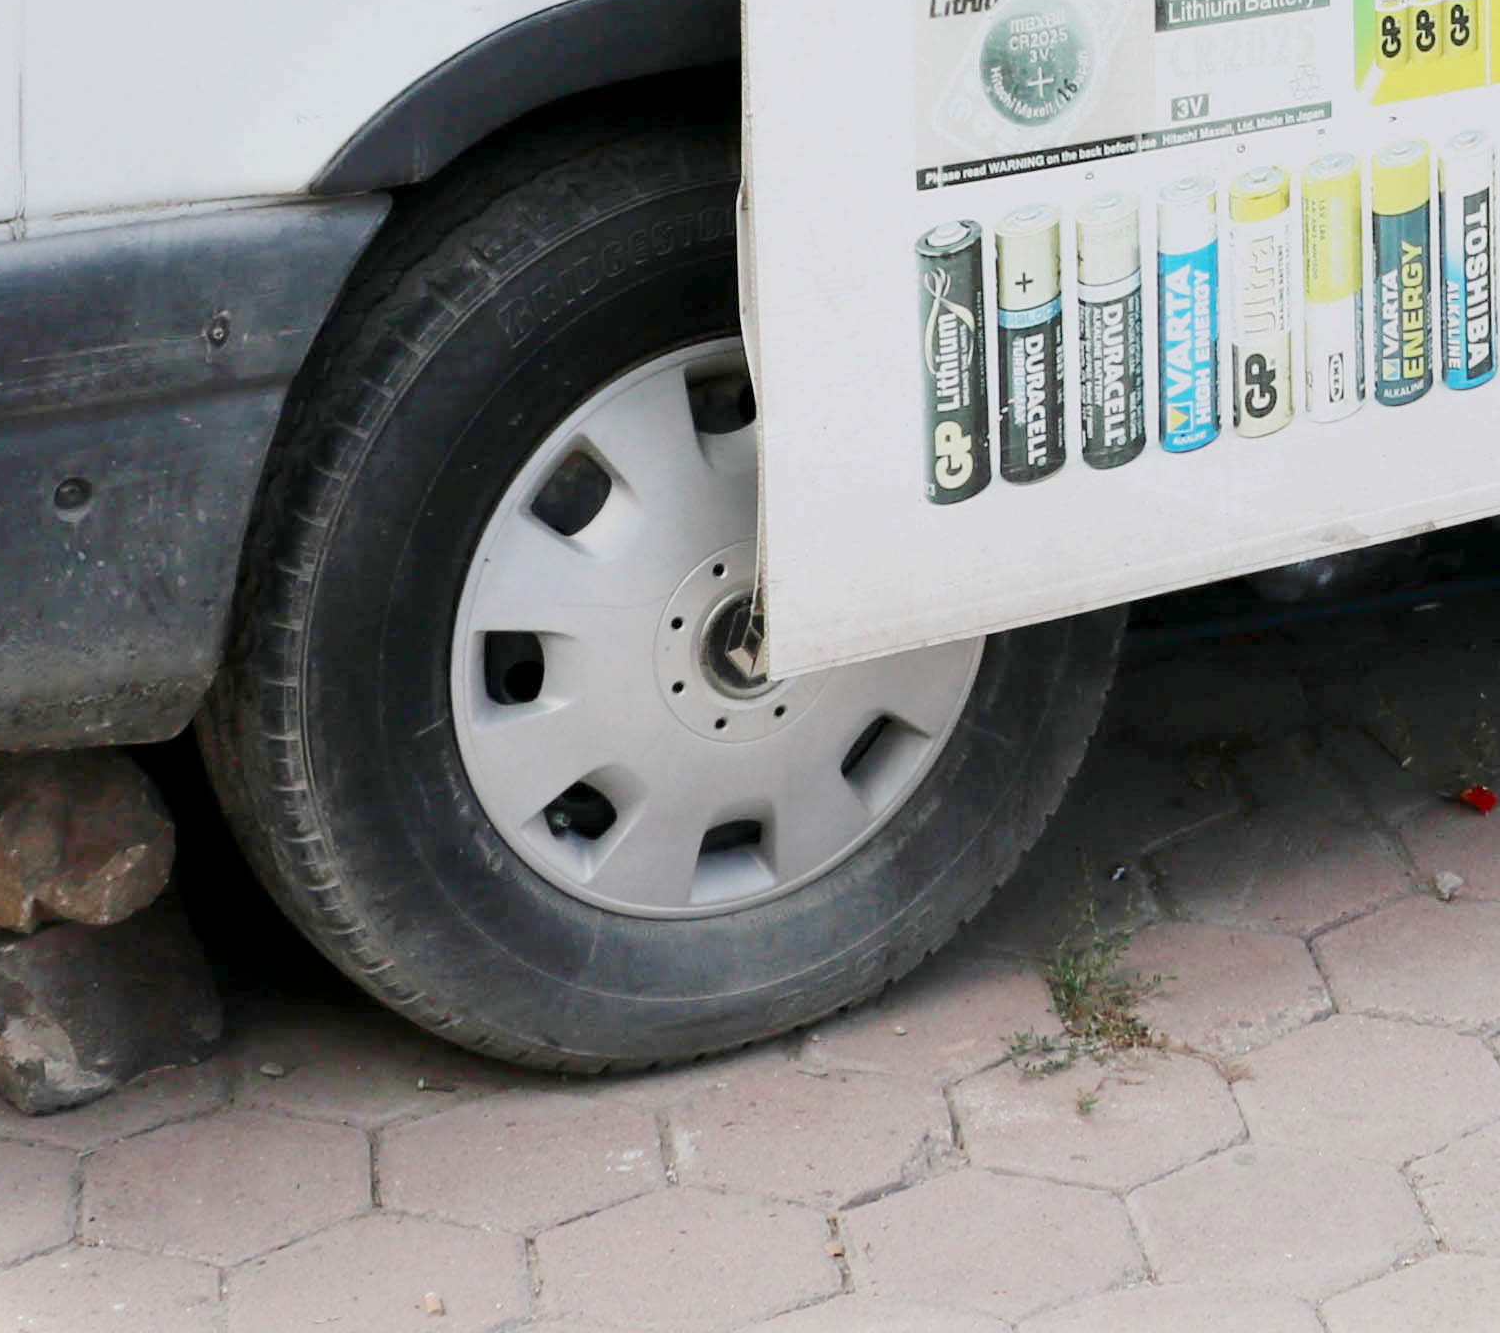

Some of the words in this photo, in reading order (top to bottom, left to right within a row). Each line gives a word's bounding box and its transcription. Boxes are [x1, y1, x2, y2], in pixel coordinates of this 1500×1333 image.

[1009, 29, 1068, 50] CR2025
[1382, 15, 1402, 58] GP
[1416, 10, 1435, 52] GP
[1451, 4, 1470, 46] GP
[1177, 96, 1203, 118] 3V
[963, 165, 987, 178] read
[988, 155, 1045, 174] WARNING
[1103, 141, 1136, 157] before
[1193, 269, 1210, 363] ENERGY
[1383, 269, 1400, 356] VARTA
[1402, 240, 1424, 379] ENERGY
[1465, 201, 1489, 368] TOSHIBA
[935, 313, 960, 413] Lithium
[1165, 264, 1192, 398] VARTA
[1024, 333, 1047, 465] DURACELL
[1102, 303, 1125, 446] DURACELL
[1195, 368, 1210, 425] HIGH
[1245, 353, 1277, 418] GP
[1383, 380, 1424, 398] ALKALINE
[935, 421, 973, 489] GP
